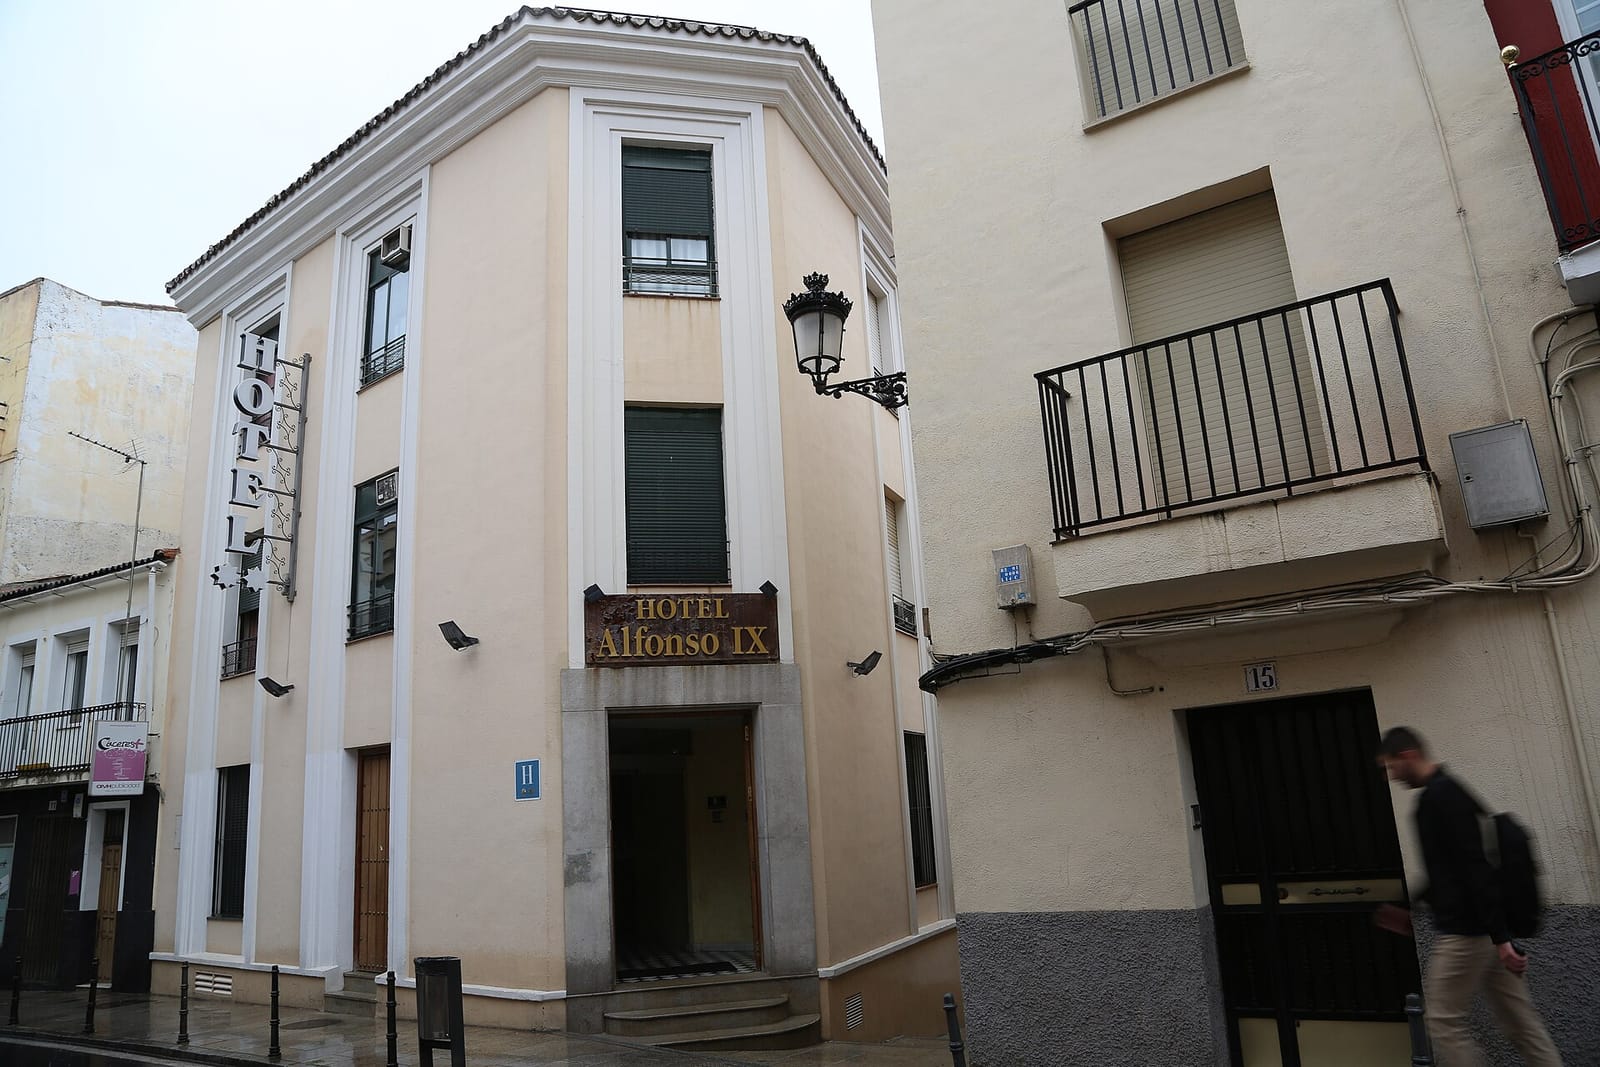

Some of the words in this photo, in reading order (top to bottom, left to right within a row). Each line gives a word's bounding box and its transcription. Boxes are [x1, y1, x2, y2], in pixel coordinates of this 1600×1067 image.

[225, 331, 279, 555] HOTEL
[635, 598, 730, 620] HOTEL
[596, 625, 720, 658] Alfonso
[731, 626, 769, 655] IX
[1249, 666, 1274, 688] 15
